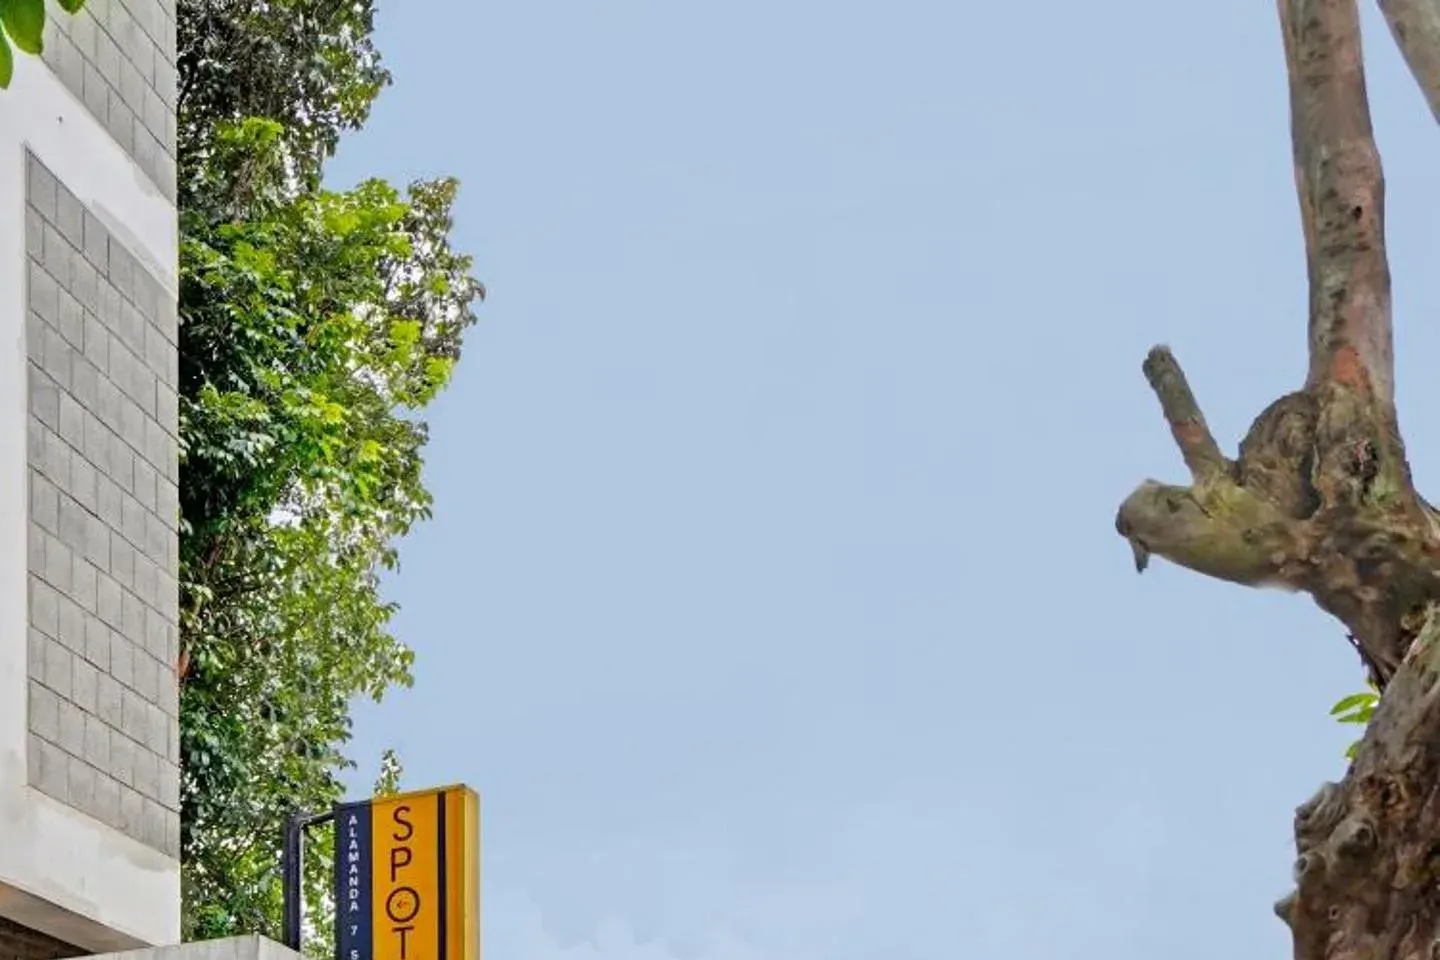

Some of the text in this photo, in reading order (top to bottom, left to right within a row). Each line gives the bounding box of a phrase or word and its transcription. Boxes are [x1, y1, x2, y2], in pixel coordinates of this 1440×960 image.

[349, 815, 359, 911] ALAMANDA
[385, 806, 421, 960] SPOT
[351, 925, 357, 936] 7
